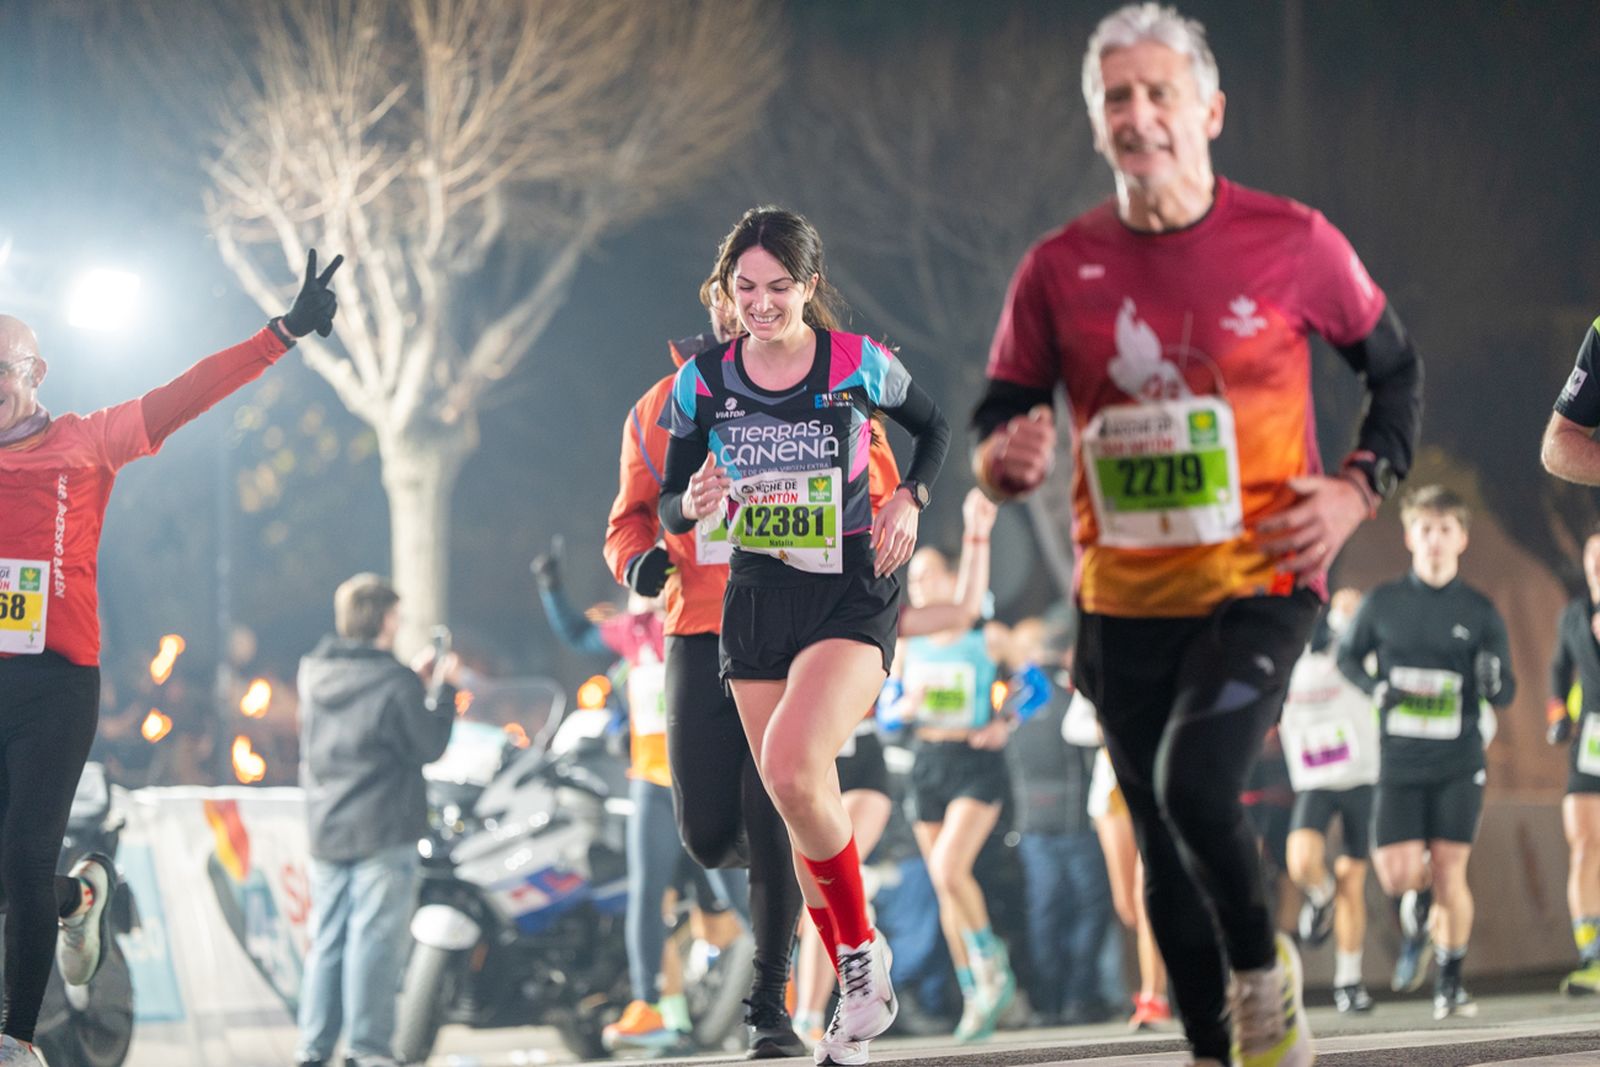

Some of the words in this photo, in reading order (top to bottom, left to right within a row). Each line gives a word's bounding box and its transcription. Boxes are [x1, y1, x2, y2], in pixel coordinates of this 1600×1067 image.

[715, 410, 746, 419] VIATOR
[1117, 453, 1204, 497] 2279
[784, 480, 798, 490] DE
[761, 490, 798, 504] ANTÓN
[745, 506, 824, 537] 12381
